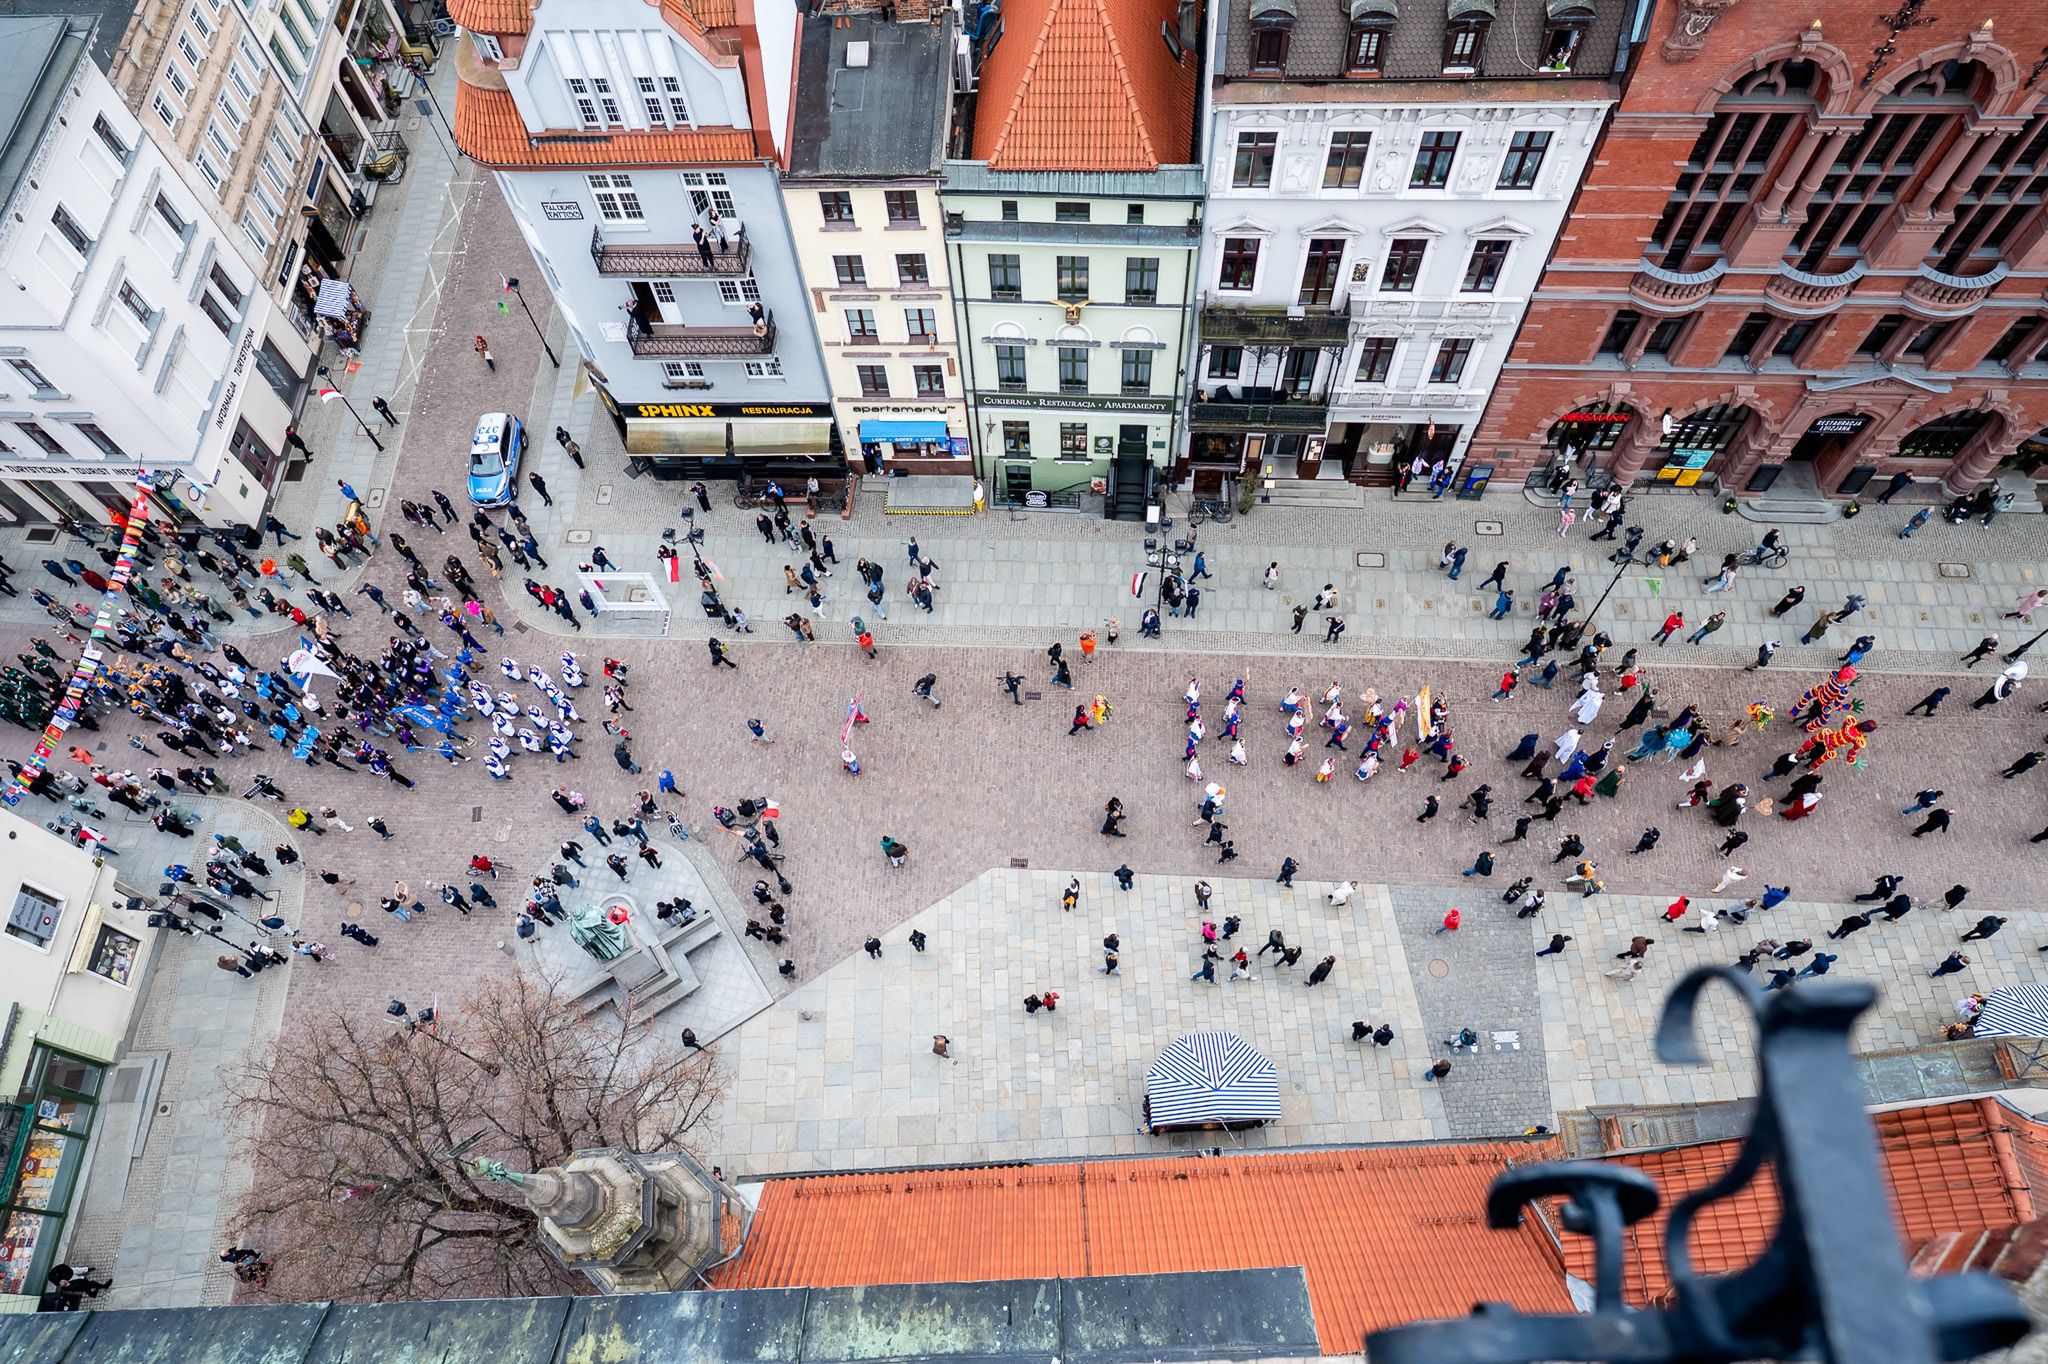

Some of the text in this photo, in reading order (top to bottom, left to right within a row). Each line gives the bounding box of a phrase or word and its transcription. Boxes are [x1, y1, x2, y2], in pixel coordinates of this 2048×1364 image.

[215, 327, 255, 429] INFORMACJA TURYSTYCZNA
[637, 405, 813, 417] SPHINX RESTAURACJA
[853, 405, 947, 414] apartamenty
[1560, 413, 1633, 422] ROSSMANN
[478, 426, 500, 434] 373
[4, 465, 70, 474] TURYSTYCZNA
[70, 467, 110, 475] TOURIST
